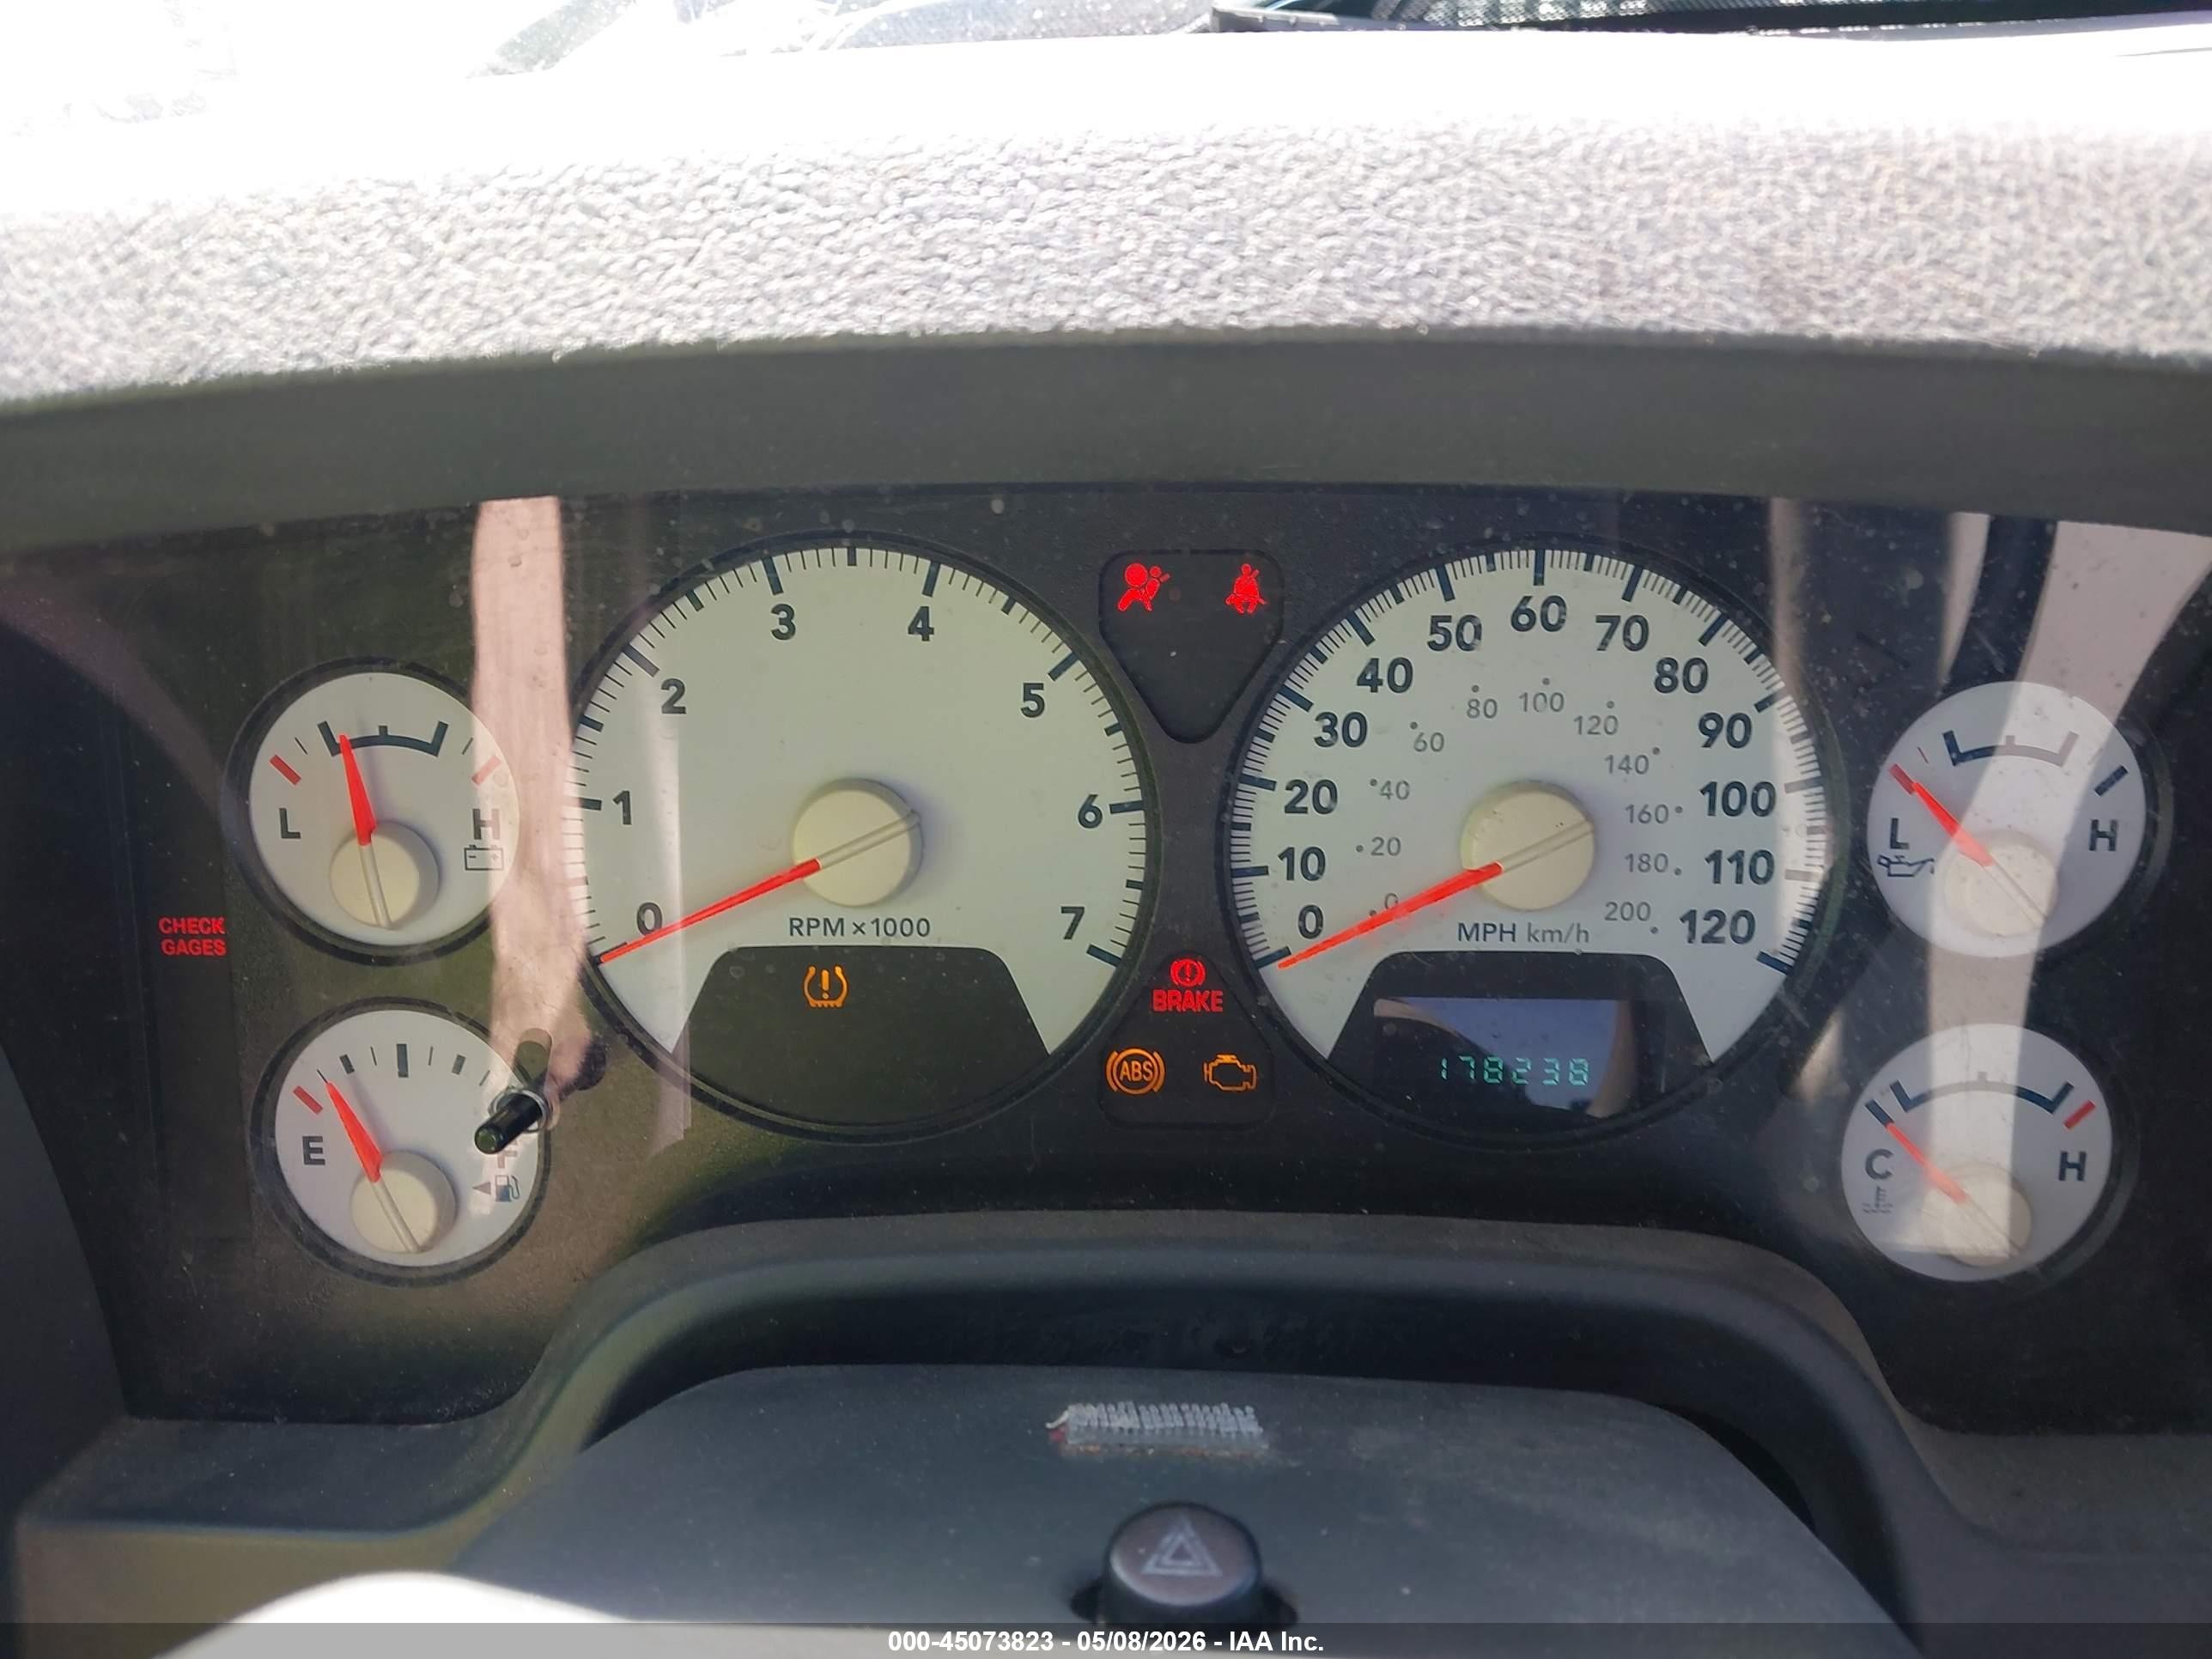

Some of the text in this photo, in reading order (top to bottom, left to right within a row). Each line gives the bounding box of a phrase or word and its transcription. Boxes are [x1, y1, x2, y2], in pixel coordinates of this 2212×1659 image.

[771, 604, 797, 640] 3
[908, 606, 935, 641] 4
[1510, 596, 1567, 632] 60
[1427, 615, 1483, 651] 50
[1595, 615, 1649, 651] 70
[1357, 658, 1413, 693] 40
[1655, 659, 1708, 694] 80
[661, 679, 687, 714] 2
[1020, 683, 1046, 718] 5
[1467, 699, 1498, 720] 80
[1518, 692, 1565, 713] 100
[1315, 712, 1368, 748] 30
[1573, 714, 1618, 736] 120
[1698, 713, 1753, 749] 90
[1413, 732, 1445, 752] 60
[1605, 754, 1650, 775] 140
[1284, 780, 1338, 815] 20
[1380, 780, 1410, 800] 40
[1700, 781, 1777, 817] 100
[612, 791, 632, 824] 1
[1078, 794, 1103, 829] 6
[1626, 804, 1668, 824] 160
[279, 808, 301, 839] L
[473, 809, 500, 840] H
[1890, 817, 1910, 848] L
[2090, 820, 2118, 851] H
[1371, 837, 1401, 856] 20
[1278, 847, 1325, 881] 10
[1625, 854, 1668, 872] 180
[1705, 850, 1775, 884] 110
[158, 917, 226, 935] CHECK
[636, 902, 663, 933] 0
[1060, 906, 1085, 939] 7
[1298, 905, 1324, 939] 0
[1605, 902, 1651, 921] 200
[789, 918, 846, 937] RPM
[1458, 922, 1589, 944] MPH km/h
[1680, 910, 1756, 945] 120
[161, 938, 227, 957] GAGES
[1152, 990, 1223, 1012] BRAKE
[1119, 1060, 1153, 1080] ABS
[1439, 1058, 1589, 1085] 178238
[302, 1135, 325, 1165] E
[1864, 1149, 1893, 1180] C
[2058, 1151, 2087, 1182] H
